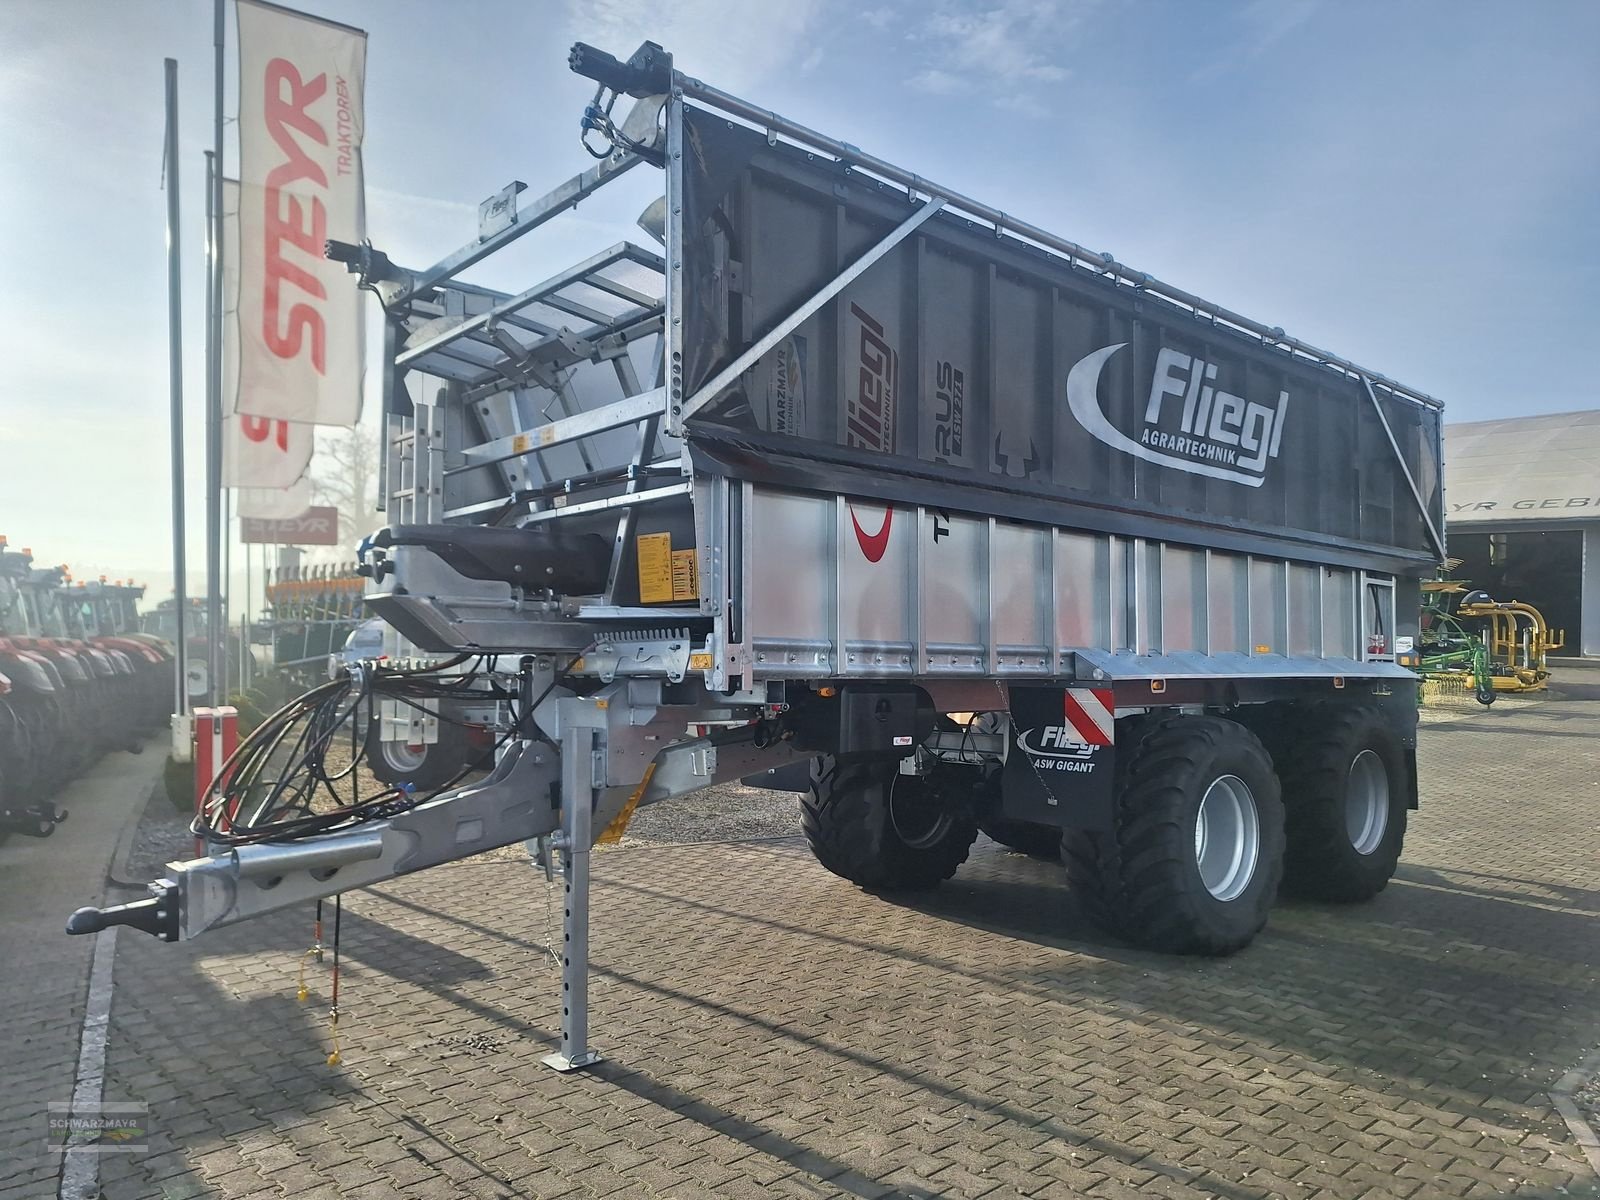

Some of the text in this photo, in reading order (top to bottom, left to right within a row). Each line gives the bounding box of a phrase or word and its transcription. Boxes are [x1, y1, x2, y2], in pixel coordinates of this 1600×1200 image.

[336, 75, 352, 177] TRAKTOREN
[263, 56, 329, 376] STEYR
[776, 350, 787, 433] WARZMAYR
[1144, 346, 1289, 473] Fliegl
[1141, 428, 1236, 465] AGRARTECHNIK
[1452, 501, 1498, 512] YR
[1034, 759, 1095, 773] ASW GIGANT
